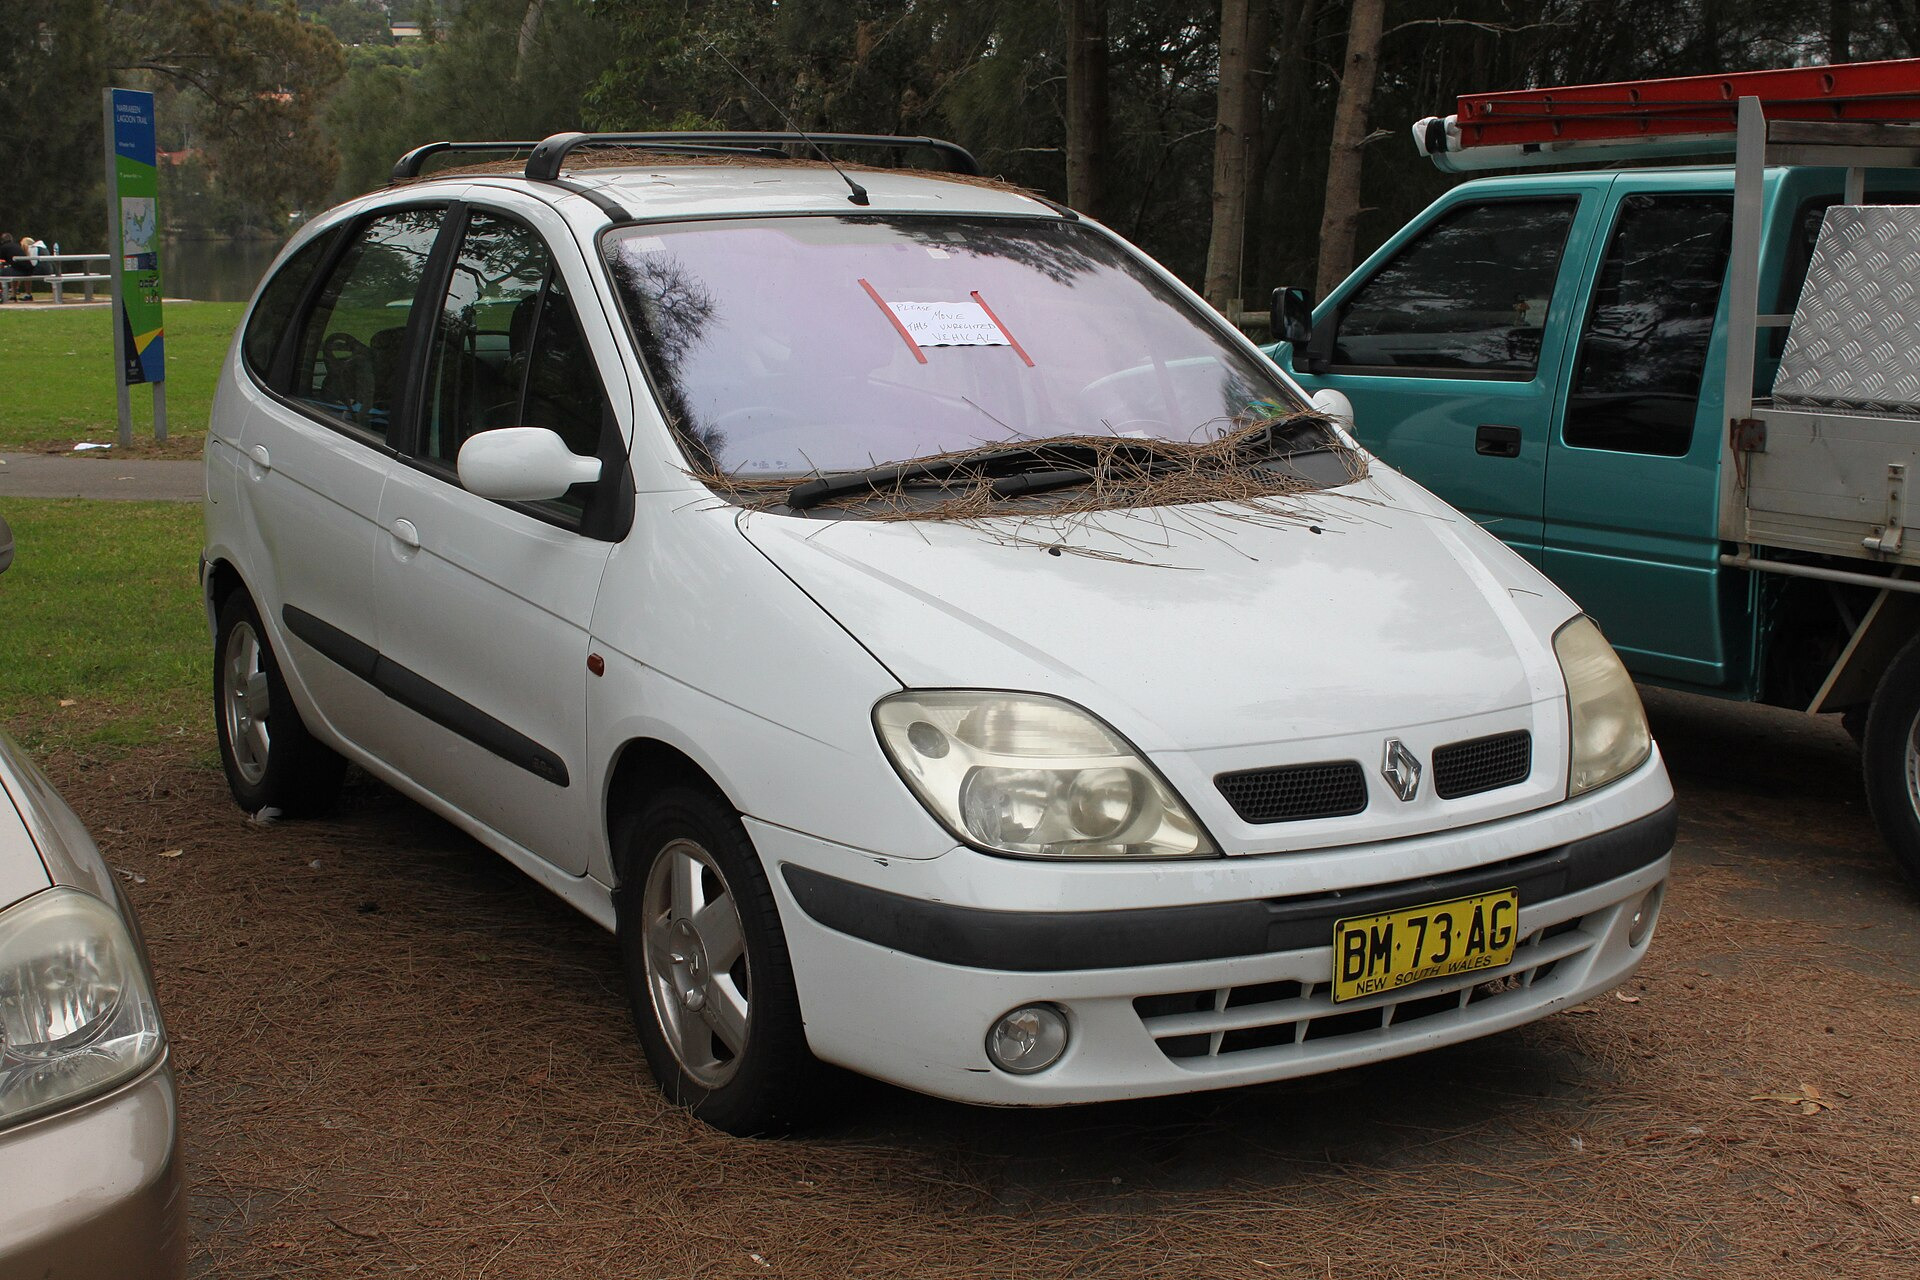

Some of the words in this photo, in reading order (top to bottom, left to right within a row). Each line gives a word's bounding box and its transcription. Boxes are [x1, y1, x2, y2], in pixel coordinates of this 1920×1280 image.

[896, 303, 931, 312] PLEASE
[931, 310, 965, 321] MOVE
[907, 322, 928, 332] THIS
[1355, 977, 1388, 995] NEW
[1394, 966, 1441, 987] SOUTH
[1449, 955, 1492, 973] WALES
